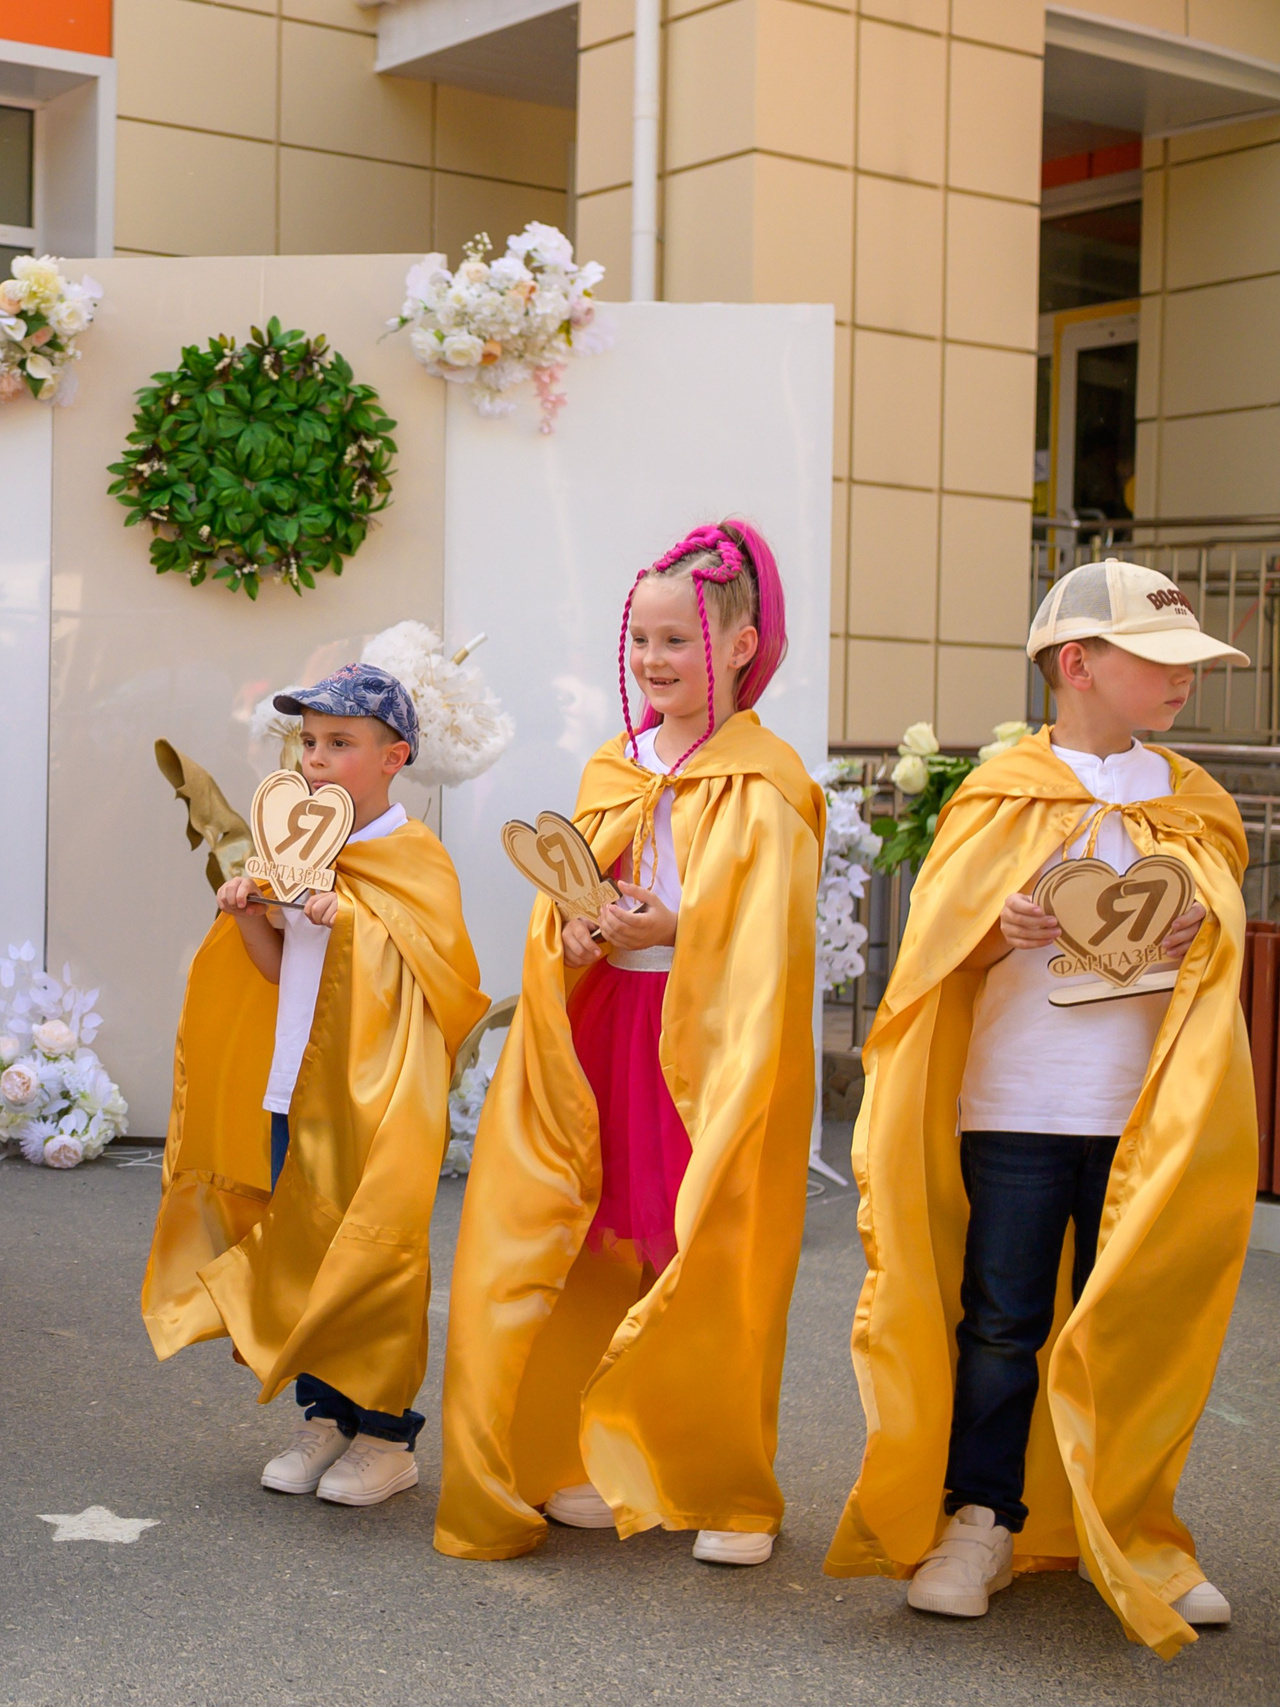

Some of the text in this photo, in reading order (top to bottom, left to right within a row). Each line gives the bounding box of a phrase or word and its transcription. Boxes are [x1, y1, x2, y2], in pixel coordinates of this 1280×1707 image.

[274, 799, 337, 861] Я
[247, 859, 333, 888] ФАНТАЗЁРЫ
[536, 832, 585, 893] Я
[1087, 879, 1168, 947] Я
[1052, 944, 1168, 975] ФАНТАЗЁР
